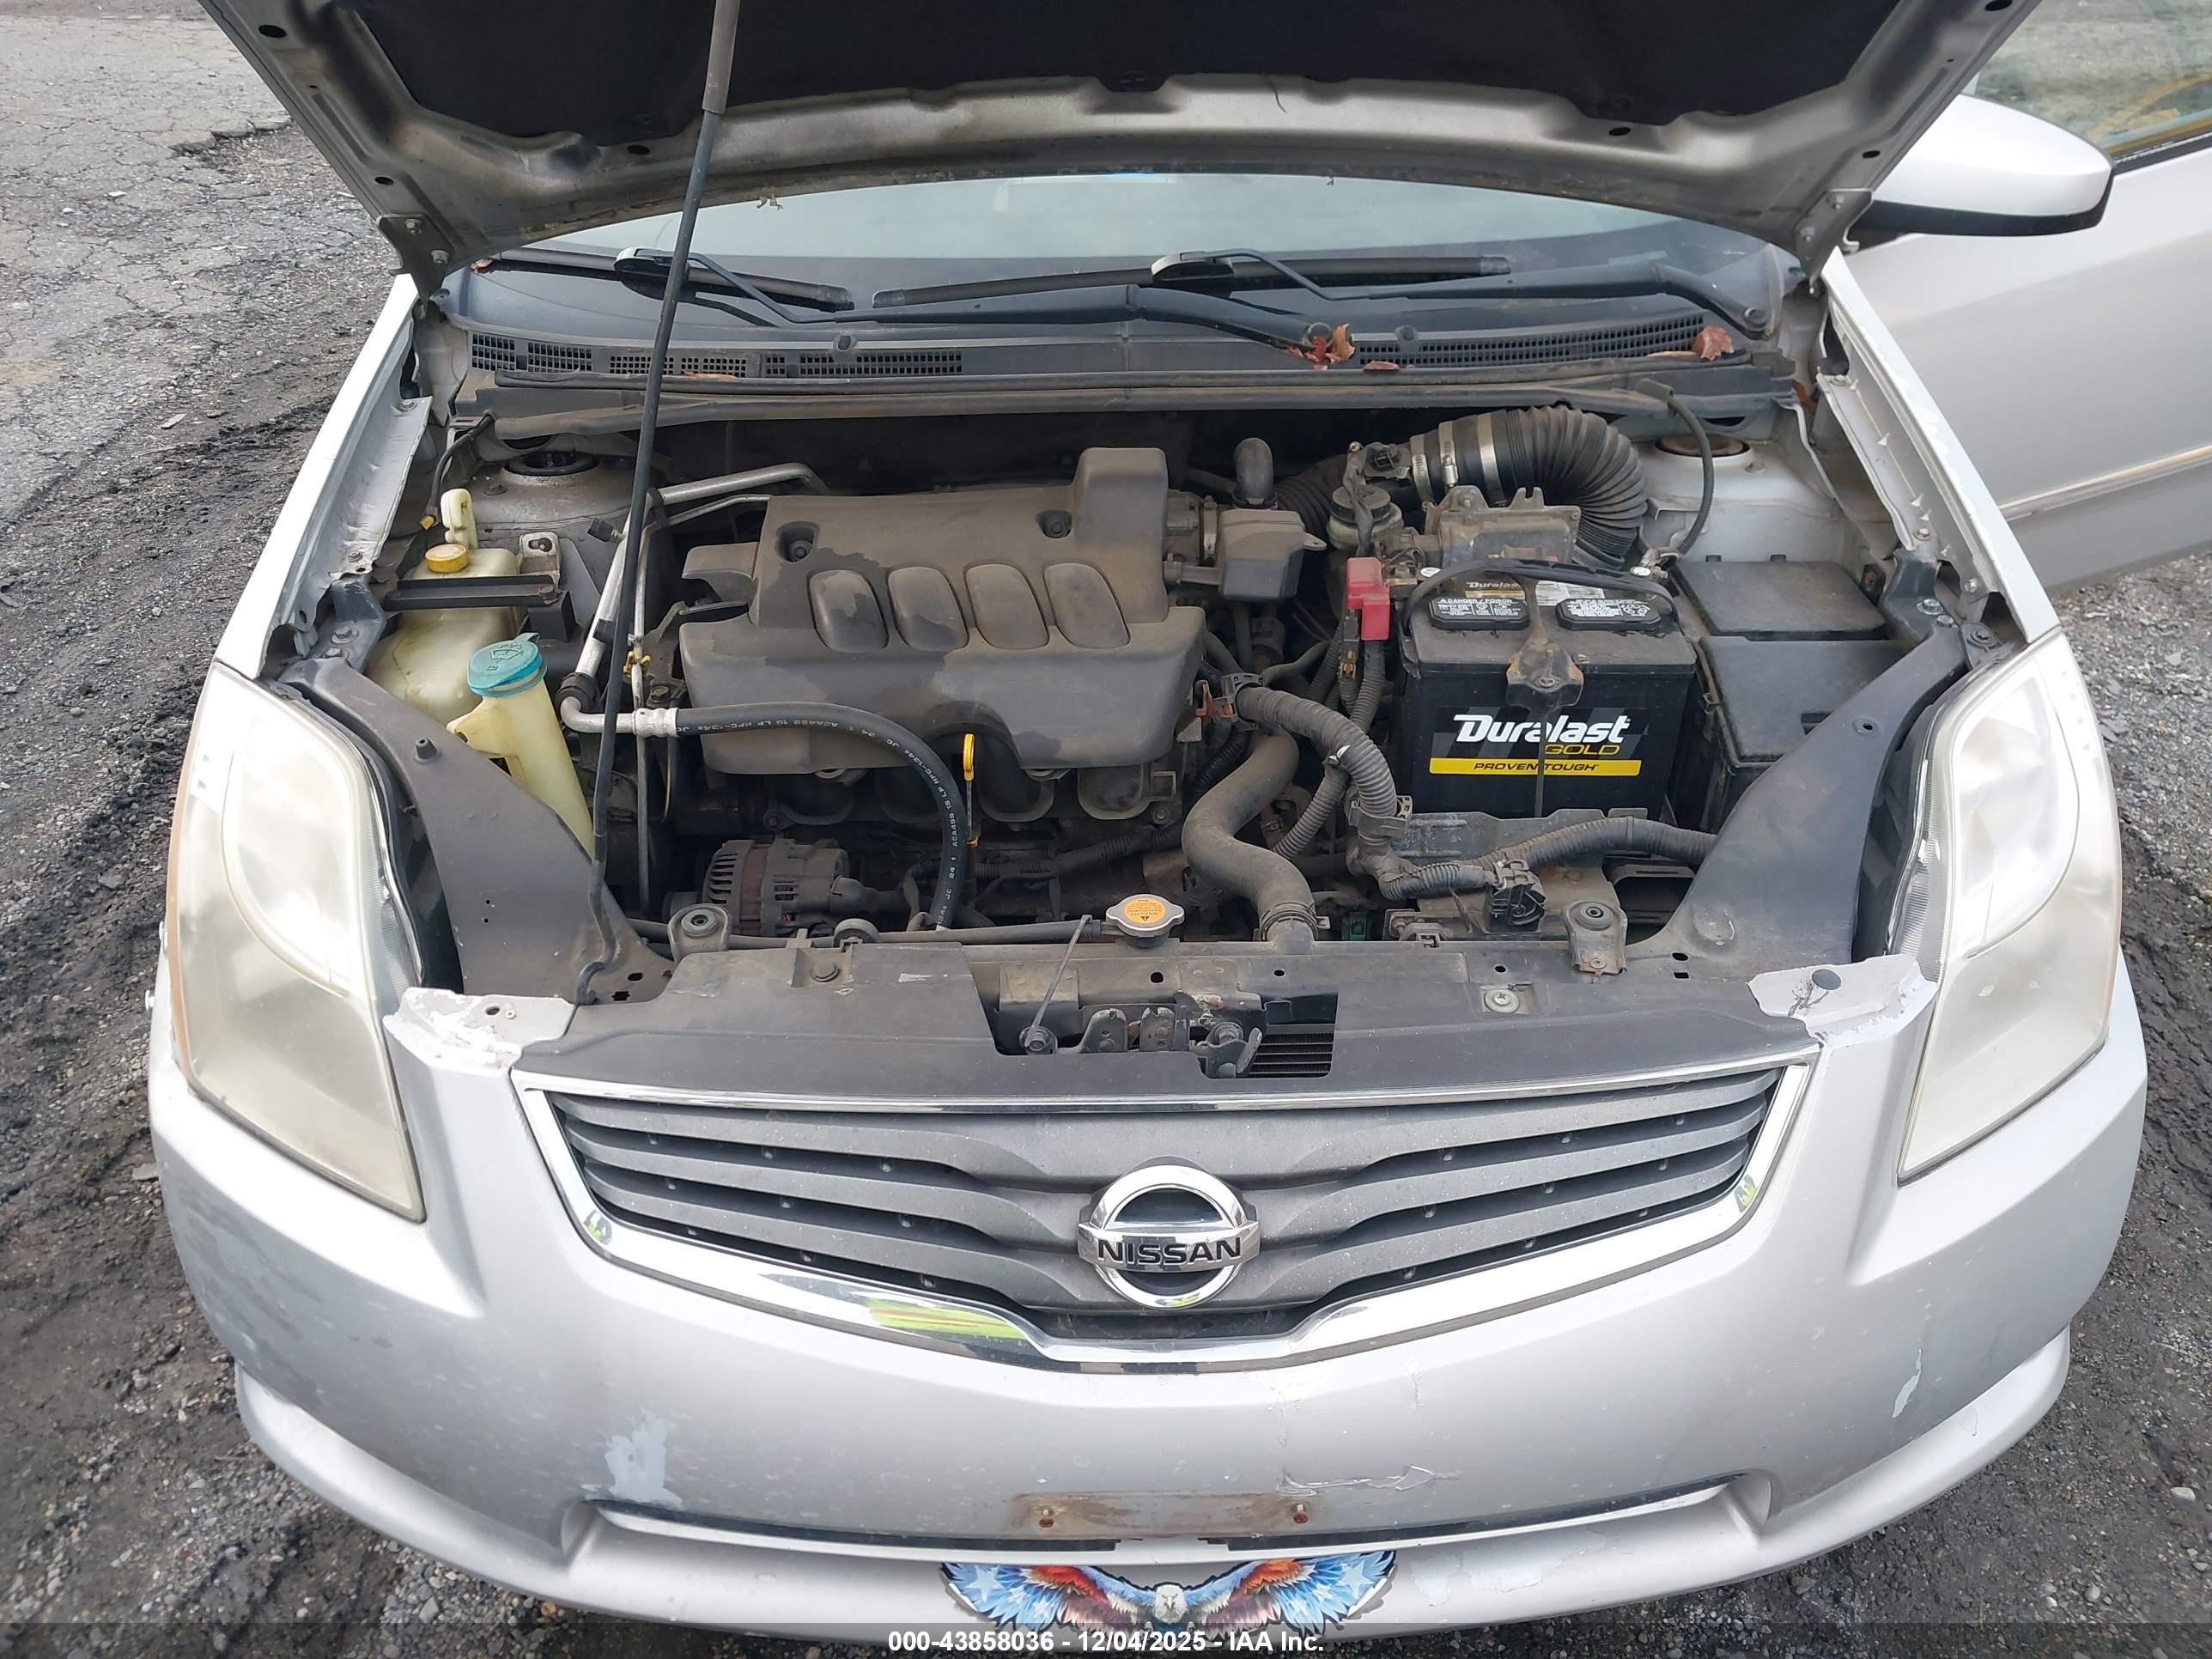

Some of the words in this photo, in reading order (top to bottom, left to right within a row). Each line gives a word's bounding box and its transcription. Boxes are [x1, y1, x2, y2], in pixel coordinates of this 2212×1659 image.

[1453, 714, 1630, 744] Duralast
[1546, 744, 1621, 756] GOLD
[1474, 762, 1539, 771] PROVEN
[1543, 763, 1597, 772] TOUGH
[1097, 1237, 1241, 1264] NISSAN
